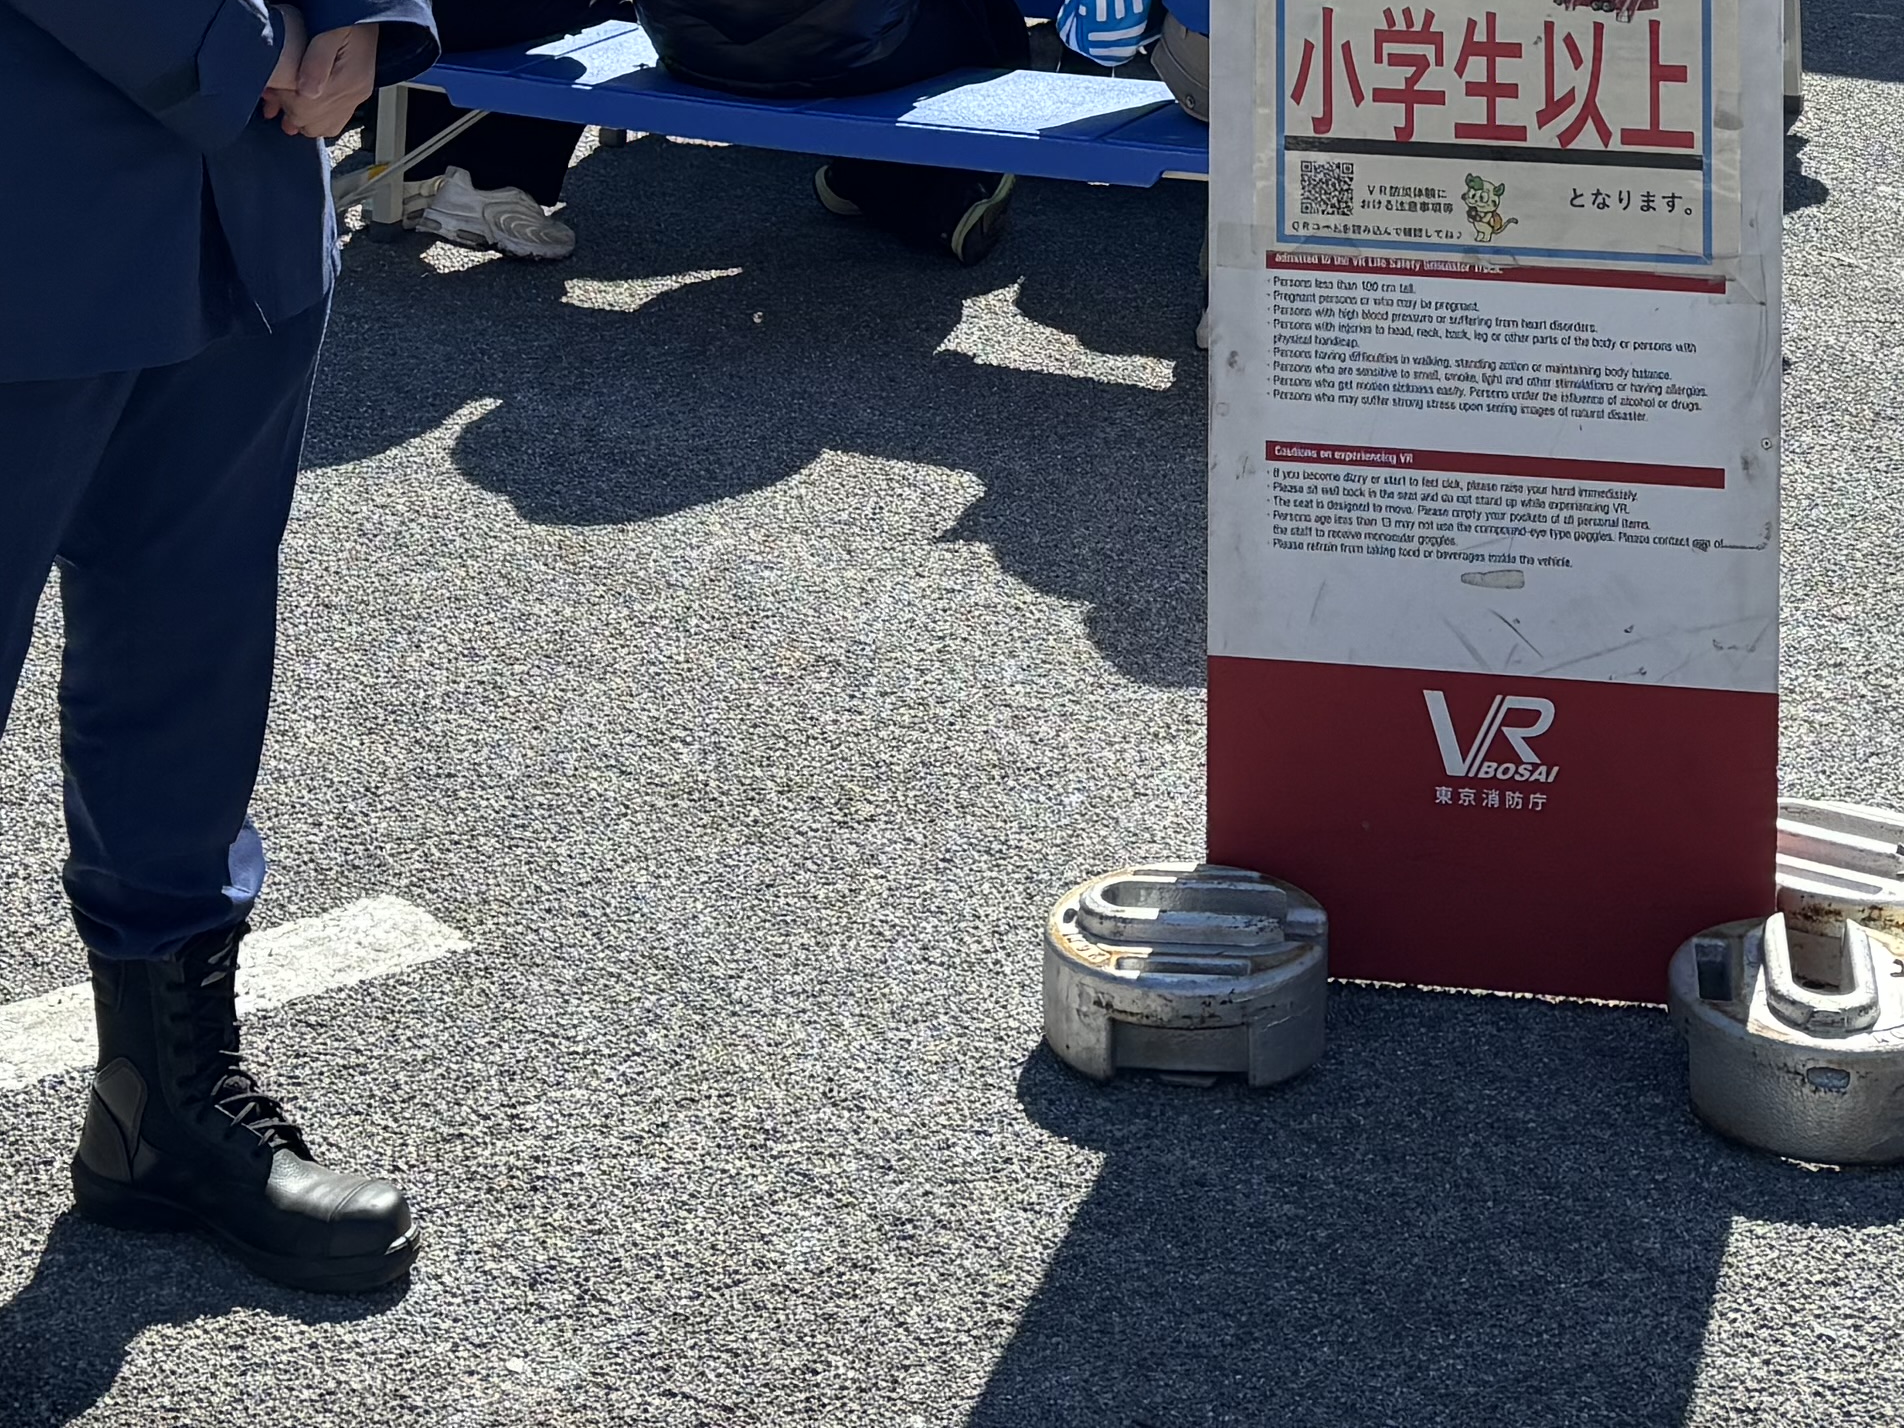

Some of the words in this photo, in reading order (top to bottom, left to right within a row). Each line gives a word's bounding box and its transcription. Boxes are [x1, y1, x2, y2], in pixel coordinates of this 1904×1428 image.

[1290, 6, 1695, 149] 小学生以上
[1568, 187, 1695, 217] となります。
[1422, 689, 1555, 777] VR
[1477, 762, 1560, 783] BOSAI
[1434, 785, 1548, 811] 東京消防庁
